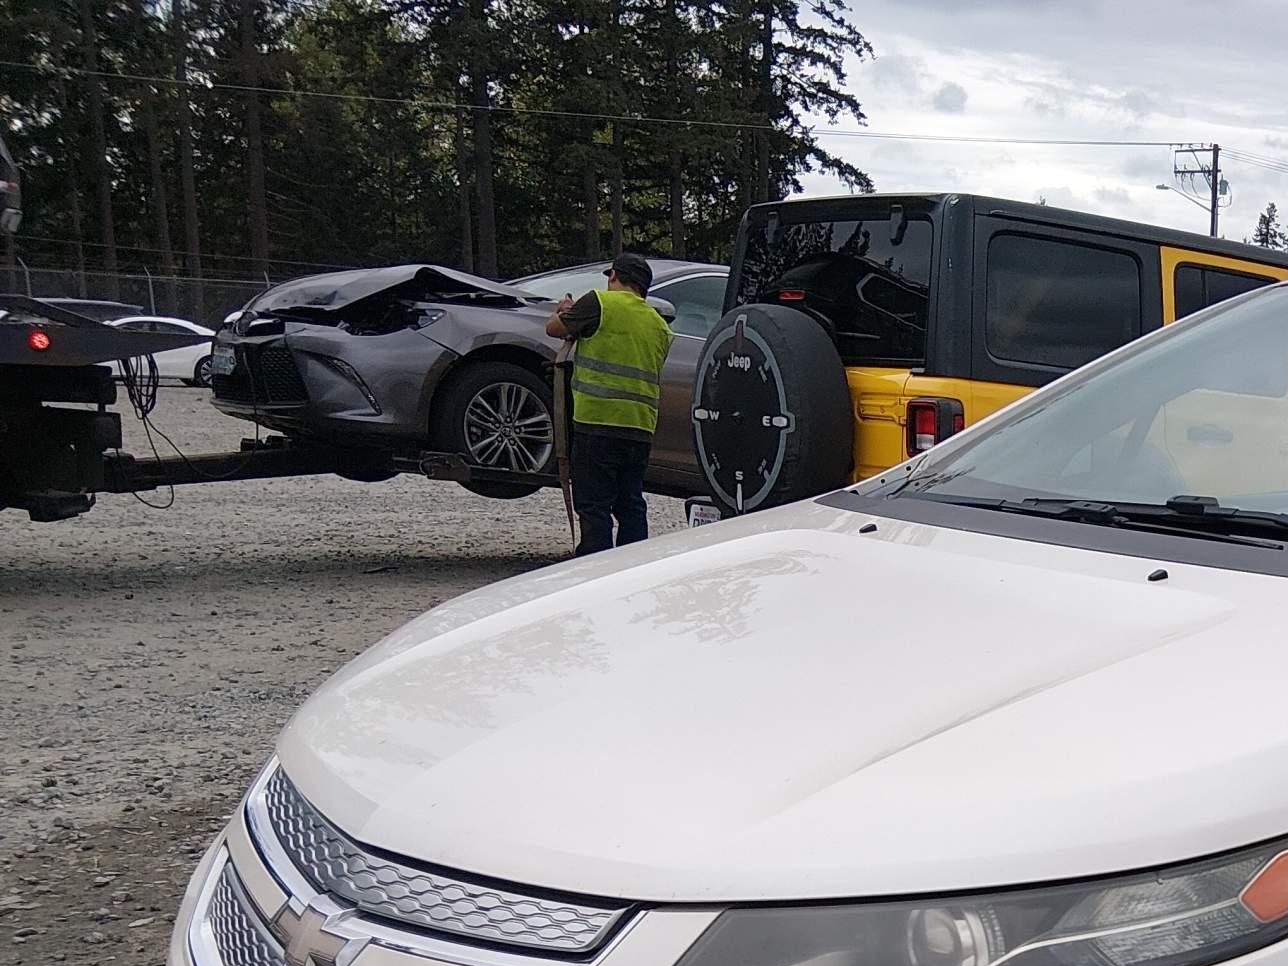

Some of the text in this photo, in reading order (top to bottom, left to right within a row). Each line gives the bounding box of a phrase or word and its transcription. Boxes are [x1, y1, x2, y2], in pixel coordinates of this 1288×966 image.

[727, 352, 751, 371] Jeep
[709, 411, 720, 421] W
[762, 416, 771, 426] E
[735, 471, 744, 481] S
